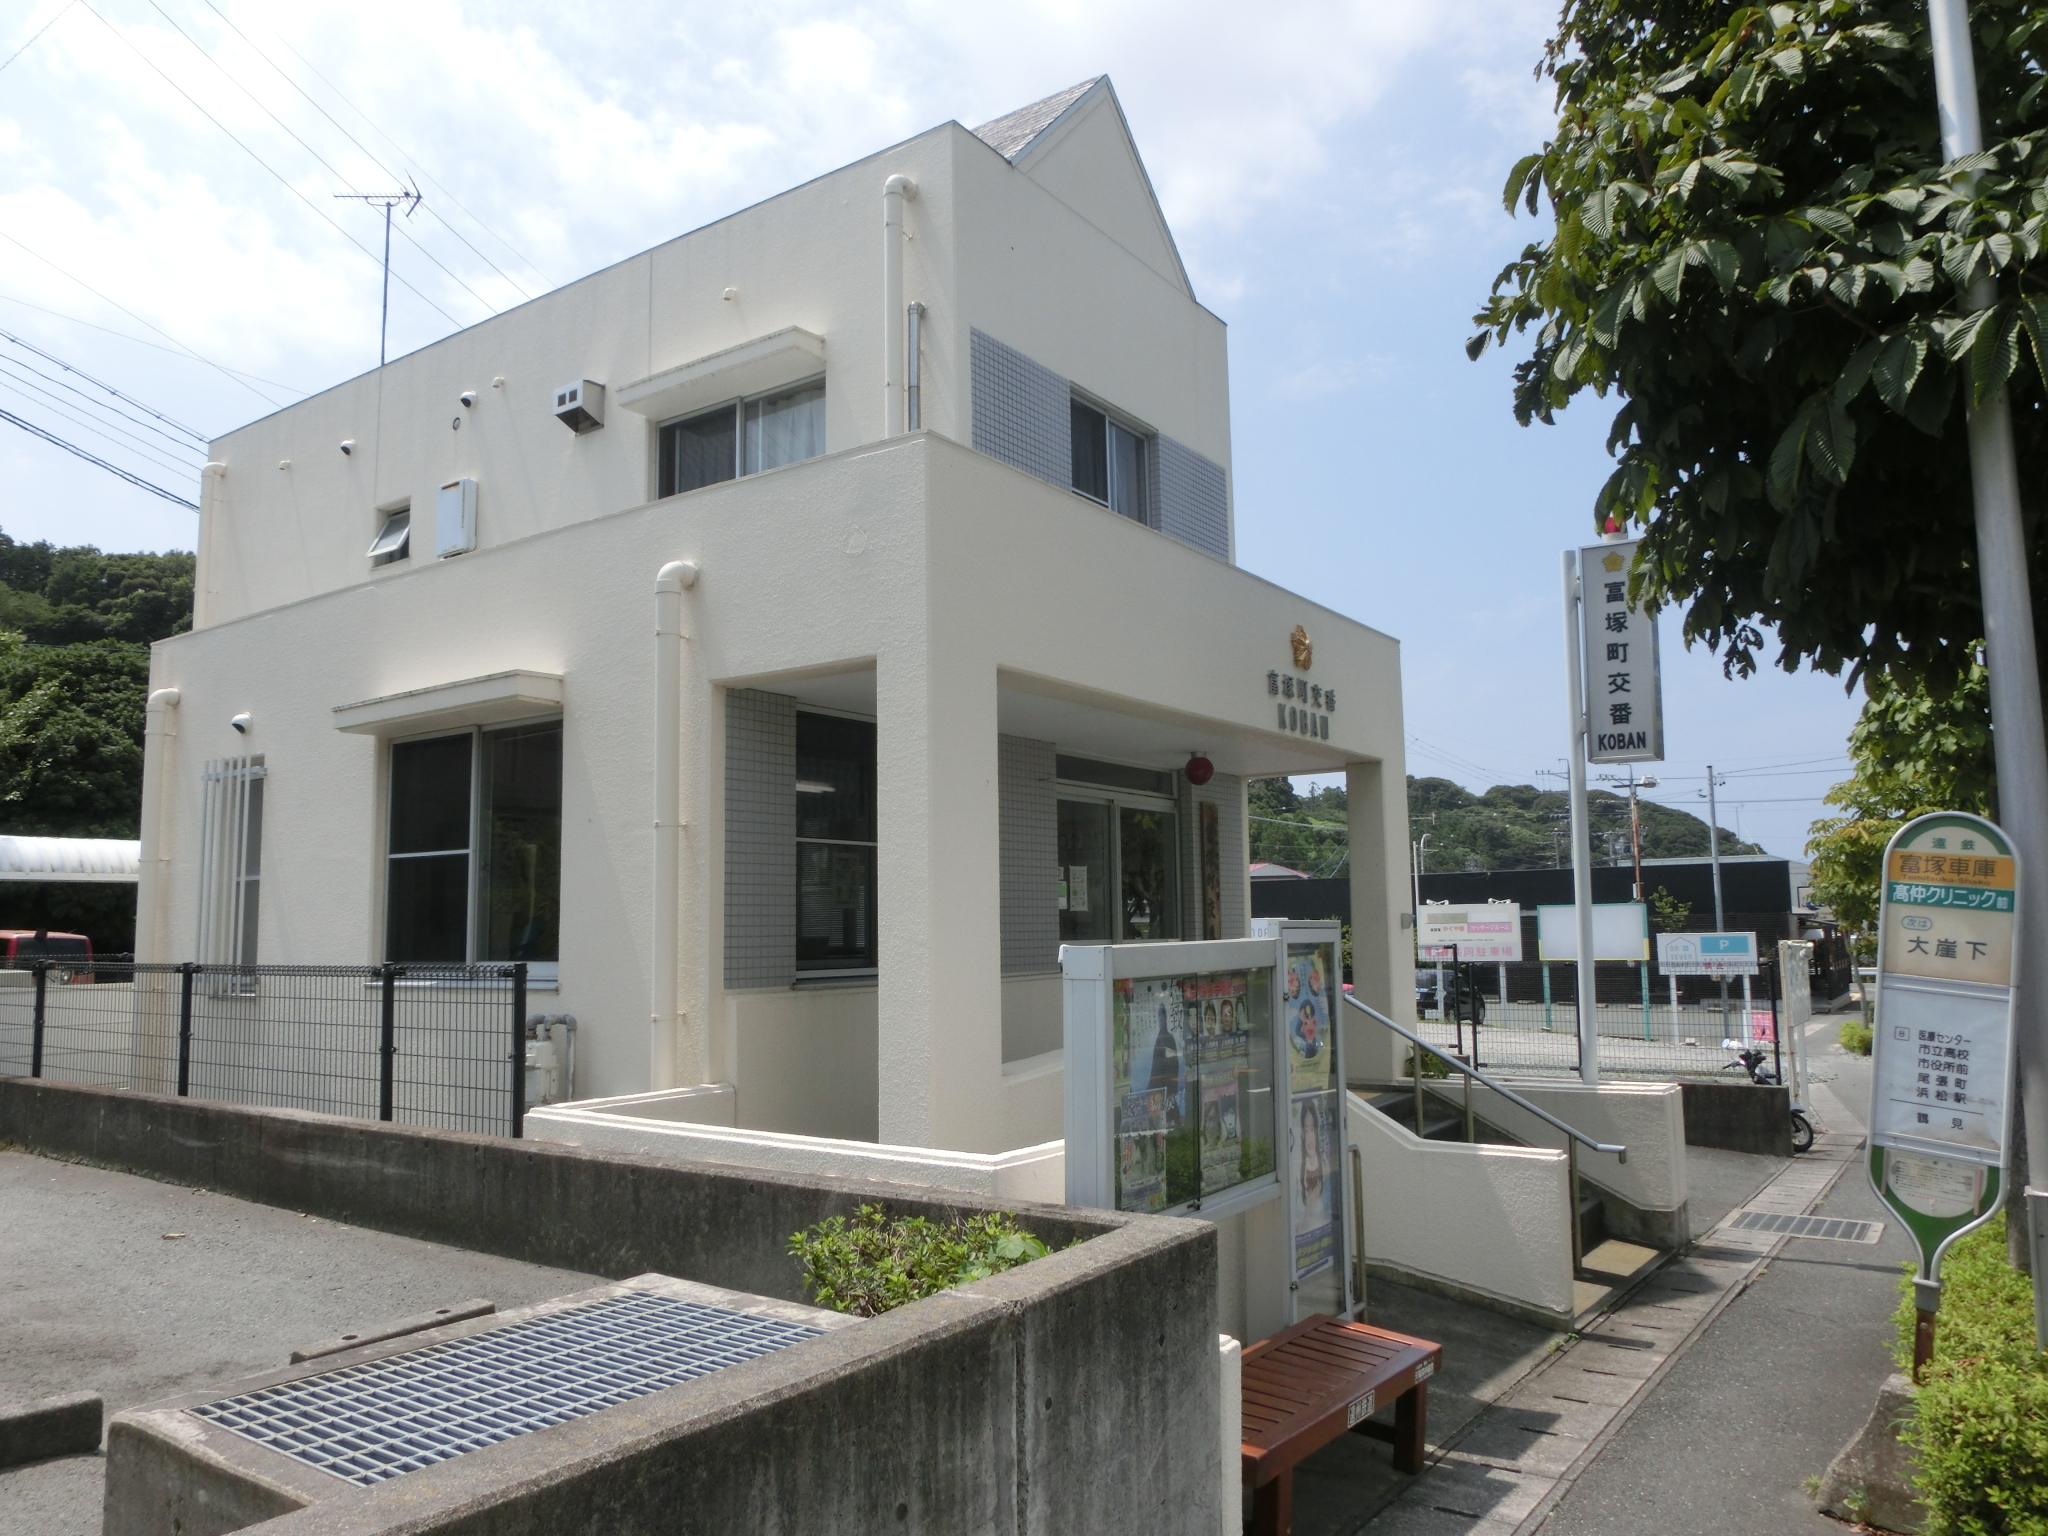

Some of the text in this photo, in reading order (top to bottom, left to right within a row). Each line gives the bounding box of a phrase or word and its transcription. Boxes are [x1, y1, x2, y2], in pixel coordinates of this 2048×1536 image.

[1604, 581, 1632, 725] 富塚町交番
[1267, 669, 1336, 712] 富塚町交番
[1277, 703, 1329, 740] KOBAN
[1598, 731, 1647, 751] KOBAN
[1931, 837, 1975, 851] 遠鉄
[1900, 854, 1997, 879] 富塚車庫
[1906, 918, 1928, 928] 次は
[1720, 940, 1729, 950] P
[1907, 936, 1987, 960] 大崖下
[1918, 1029, 1971, 1046] 医療センター
[1918, 1044, 1970, 1061] 市立高校
[1918, 1058, 1968, 1075] 市役所前
[1917, 1072, 1967, 1090] 尾張町
[1917, 1087, 1967, 1105] 浜松駅
[1917, 1112, 1963, 1130] 鶴見
